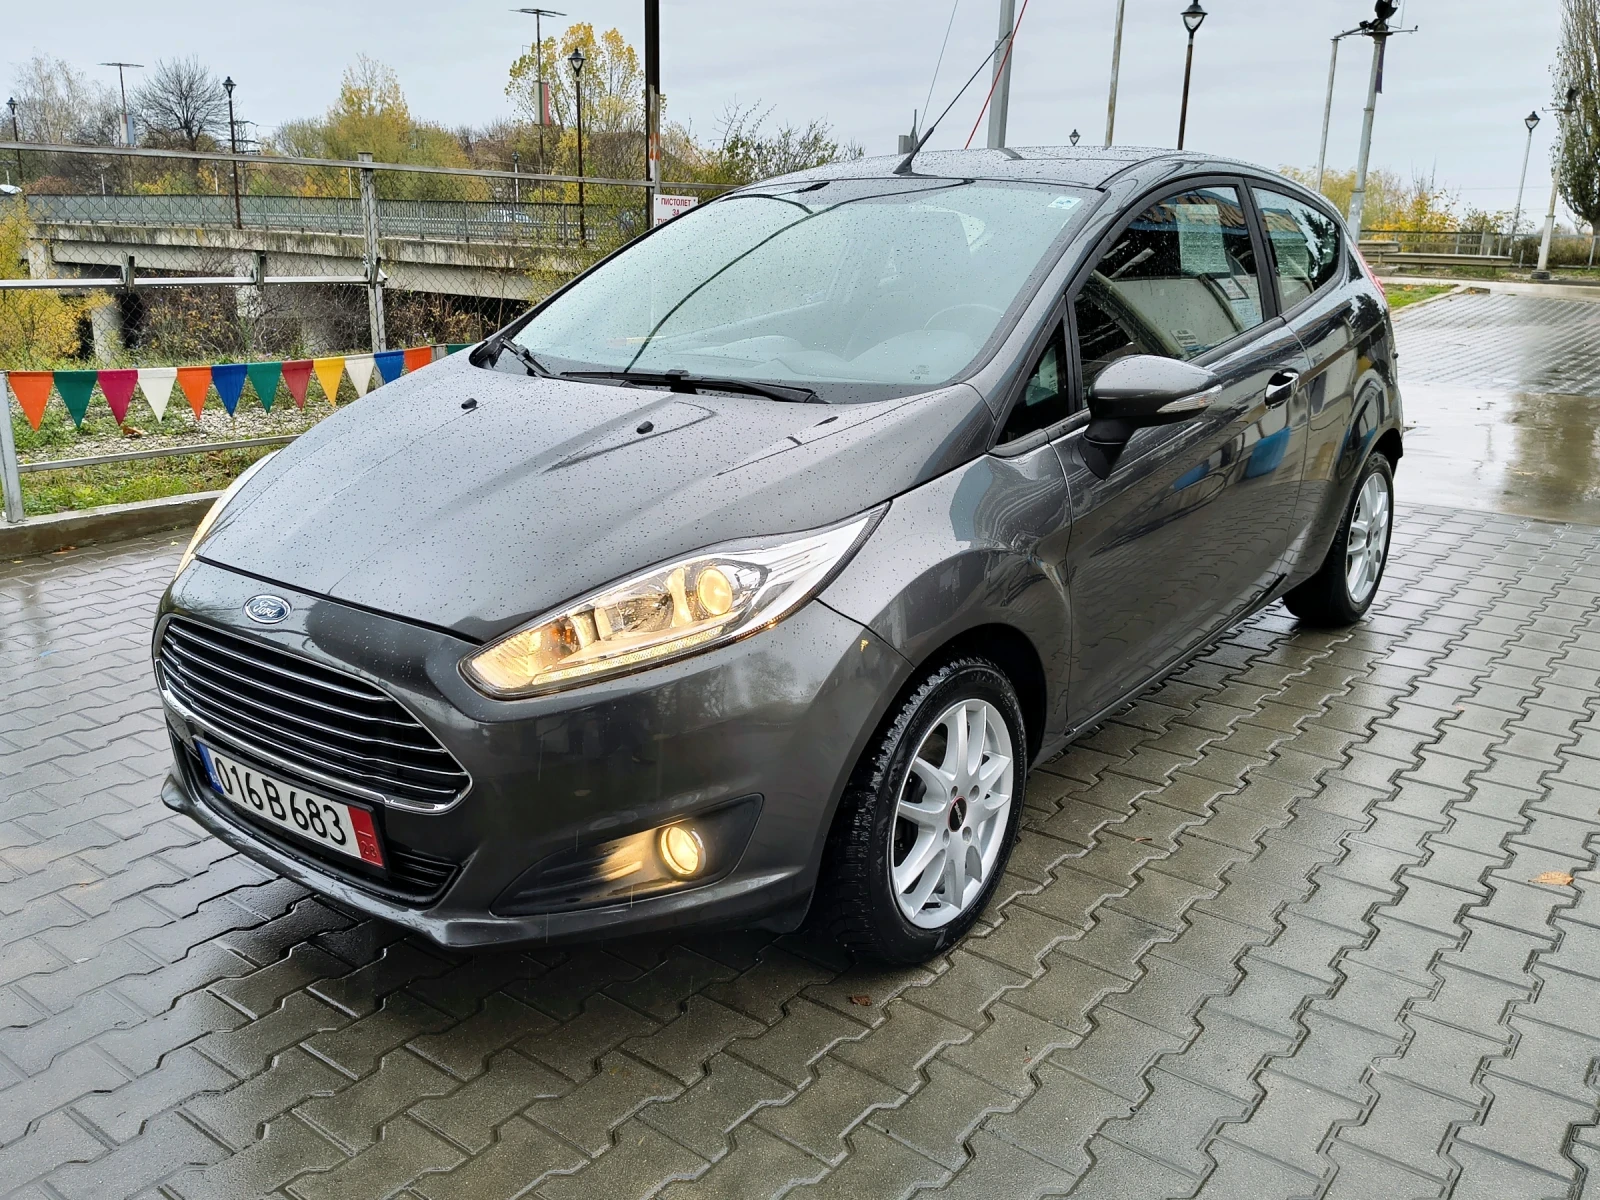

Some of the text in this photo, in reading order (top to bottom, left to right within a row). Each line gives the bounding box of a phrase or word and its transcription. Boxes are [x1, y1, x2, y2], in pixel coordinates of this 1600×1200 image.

[661, 198, 691, 207] ПИСТОЛЕТ
[672, 209, 680, 217] ЗА
[253, 600, 281, 617] Ford
